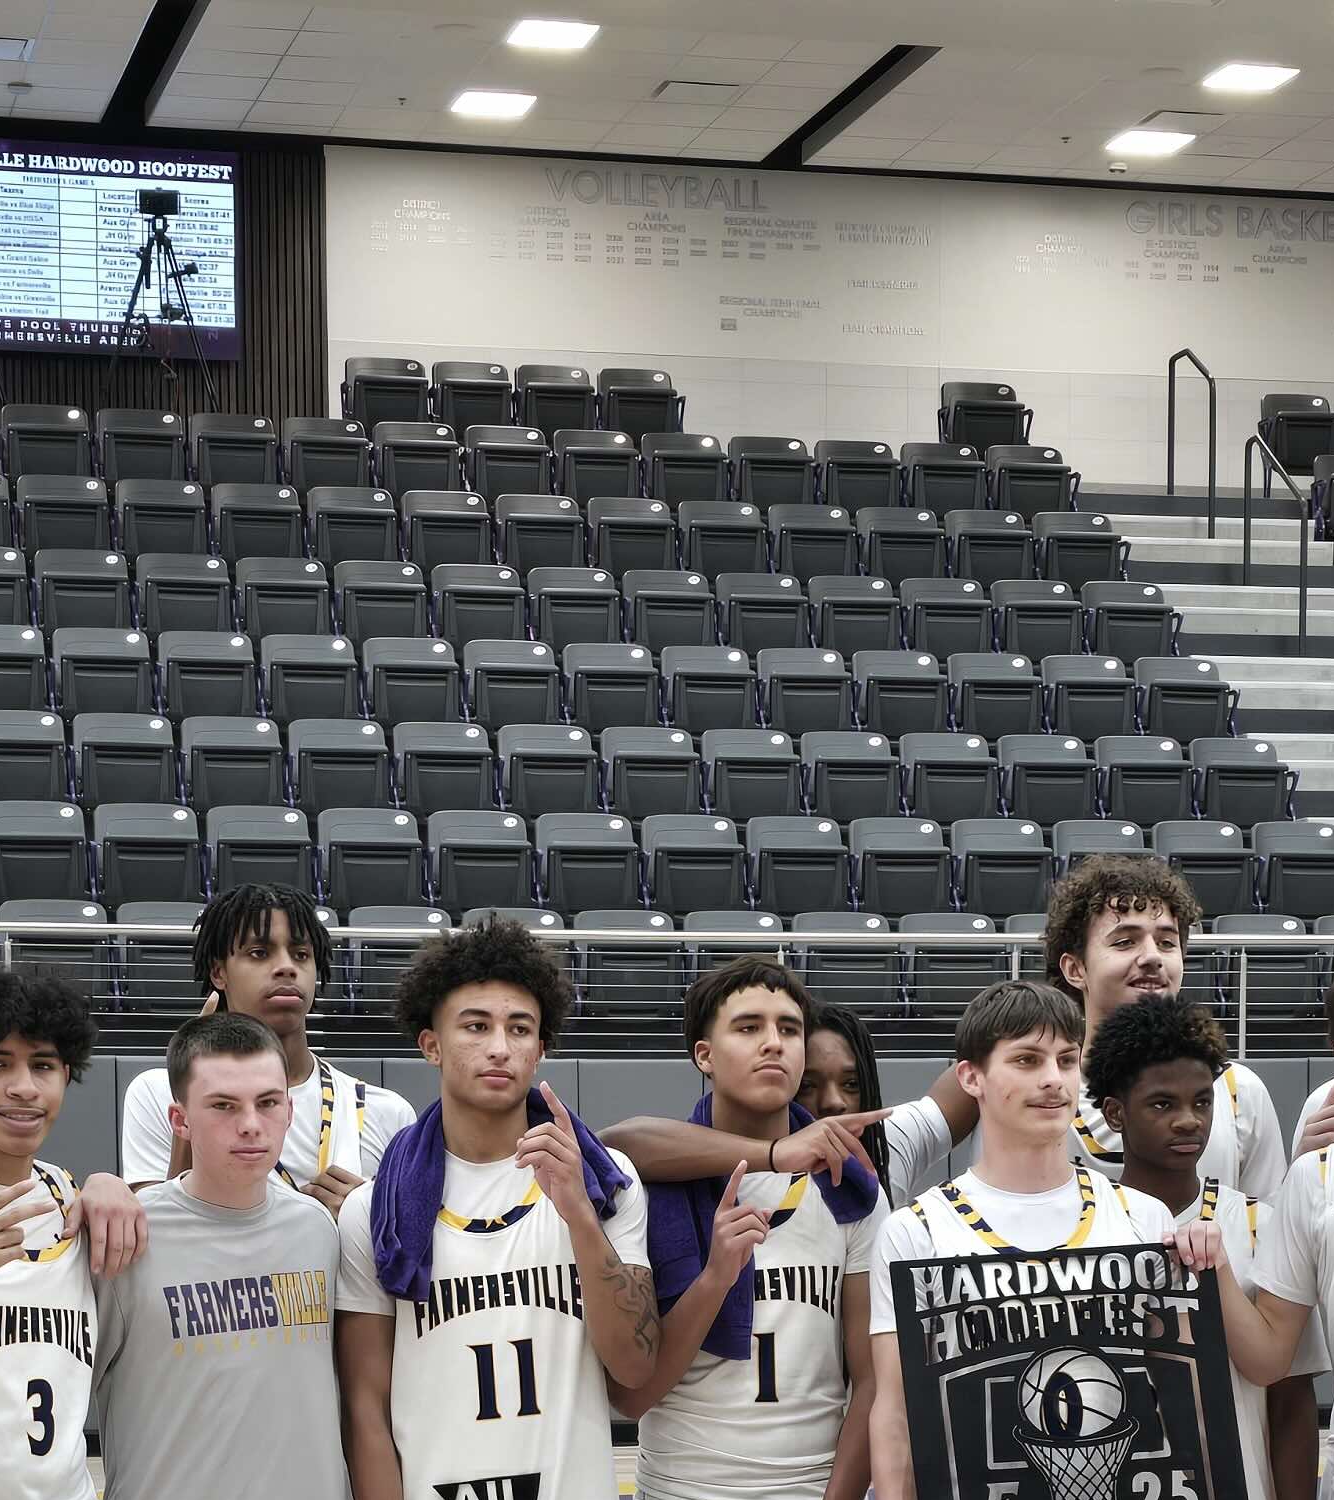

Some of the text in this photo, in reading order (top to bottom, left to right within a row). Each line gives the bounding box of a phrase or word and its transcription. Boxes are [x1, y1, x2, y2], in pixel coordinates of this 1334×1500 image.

[28, 154, 135, 175] HARDWOOD
[138, 160, 233, 180] HOOPFEST
[545, 167, 769, 213] VOLLEYBALL
[1124, 199, 1223, 238] GIRLS
[20, 320, 61, 331] POOL
[163, 1270, 329, 1339] FARMERSVILLE
[909, 1250, 1200, 1313] HARDWOOD
[465, 1338, 542, 1421] 11
[753, 1332, 779, 1403] 1
[25, 1377, 56, 1457] 3
